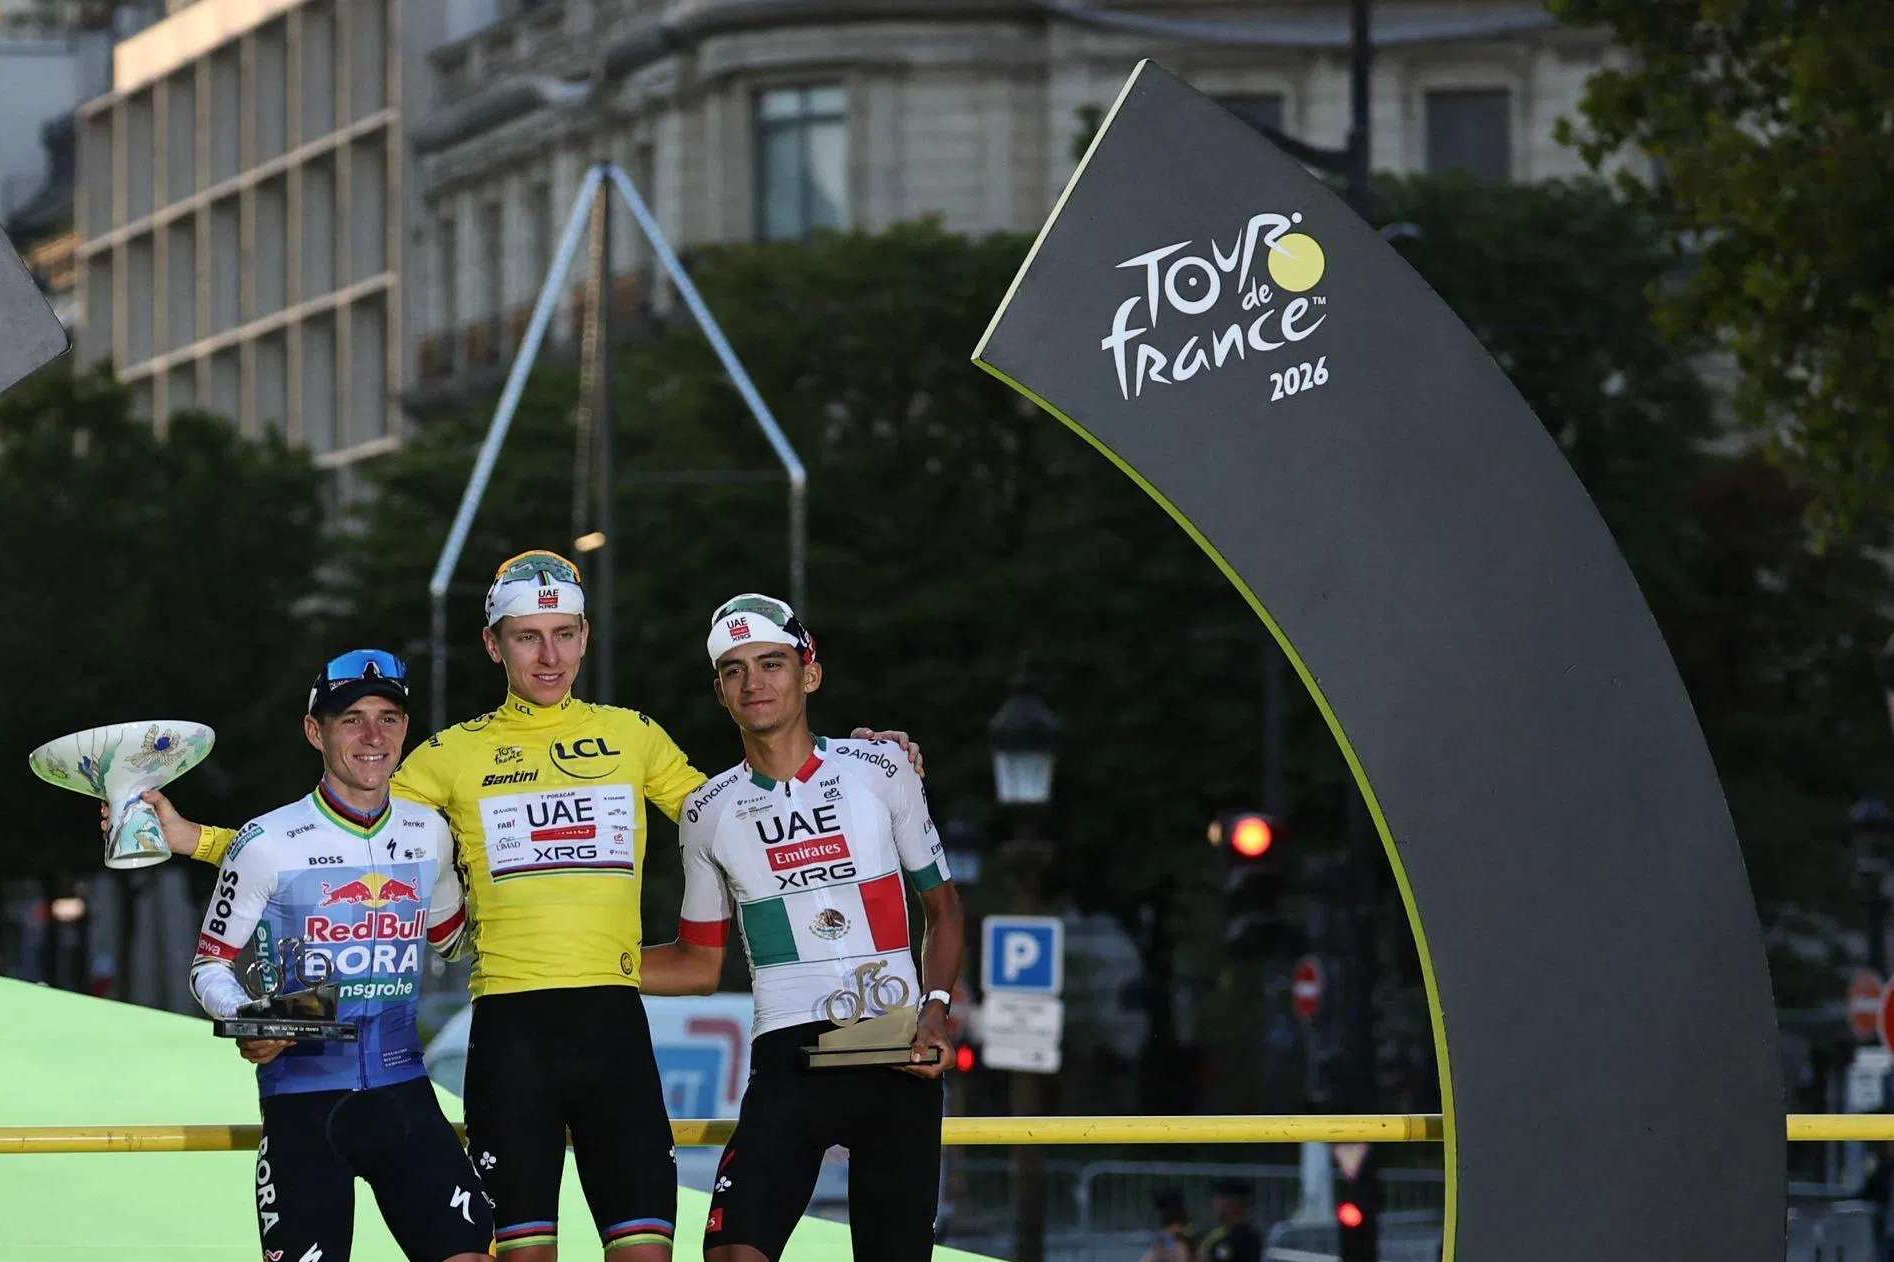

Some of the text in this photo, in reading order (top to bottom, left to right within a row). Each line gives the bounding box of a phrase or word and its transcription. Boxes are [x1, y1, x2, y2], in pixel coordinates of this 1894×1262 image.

[1115, 212, 1303, 328] TOUR
[1241, 276, 1274, 311] de
[1270, 356, 1329, 402] 2026
[726, 617, 748, 629] UAE
[514, 702, 534, 716] LCL
[554, 737, 621, 760] LCL
[847, 749, 899, 778] Analog
[481, 769, 540, 787] Santini
[694, 773, 739, 812] Analog
[526, 797, 595, 828] UAE
[755, 804, 841, 845] UAE
[308, 856, 344, 866] BOSS
[534, 845, 597, 862] XRG
[774, 843, 841, 865] Emirates
[774, 861, 856, 890] XRG
[208, 869, 239, 936] BOSS
[305, 943, 418, 977] BORA
[1003, 931, 1041, 982] P
[339, 978, 413, 999] nsgrohe
[256, 1135, 280, 1237] BORA
